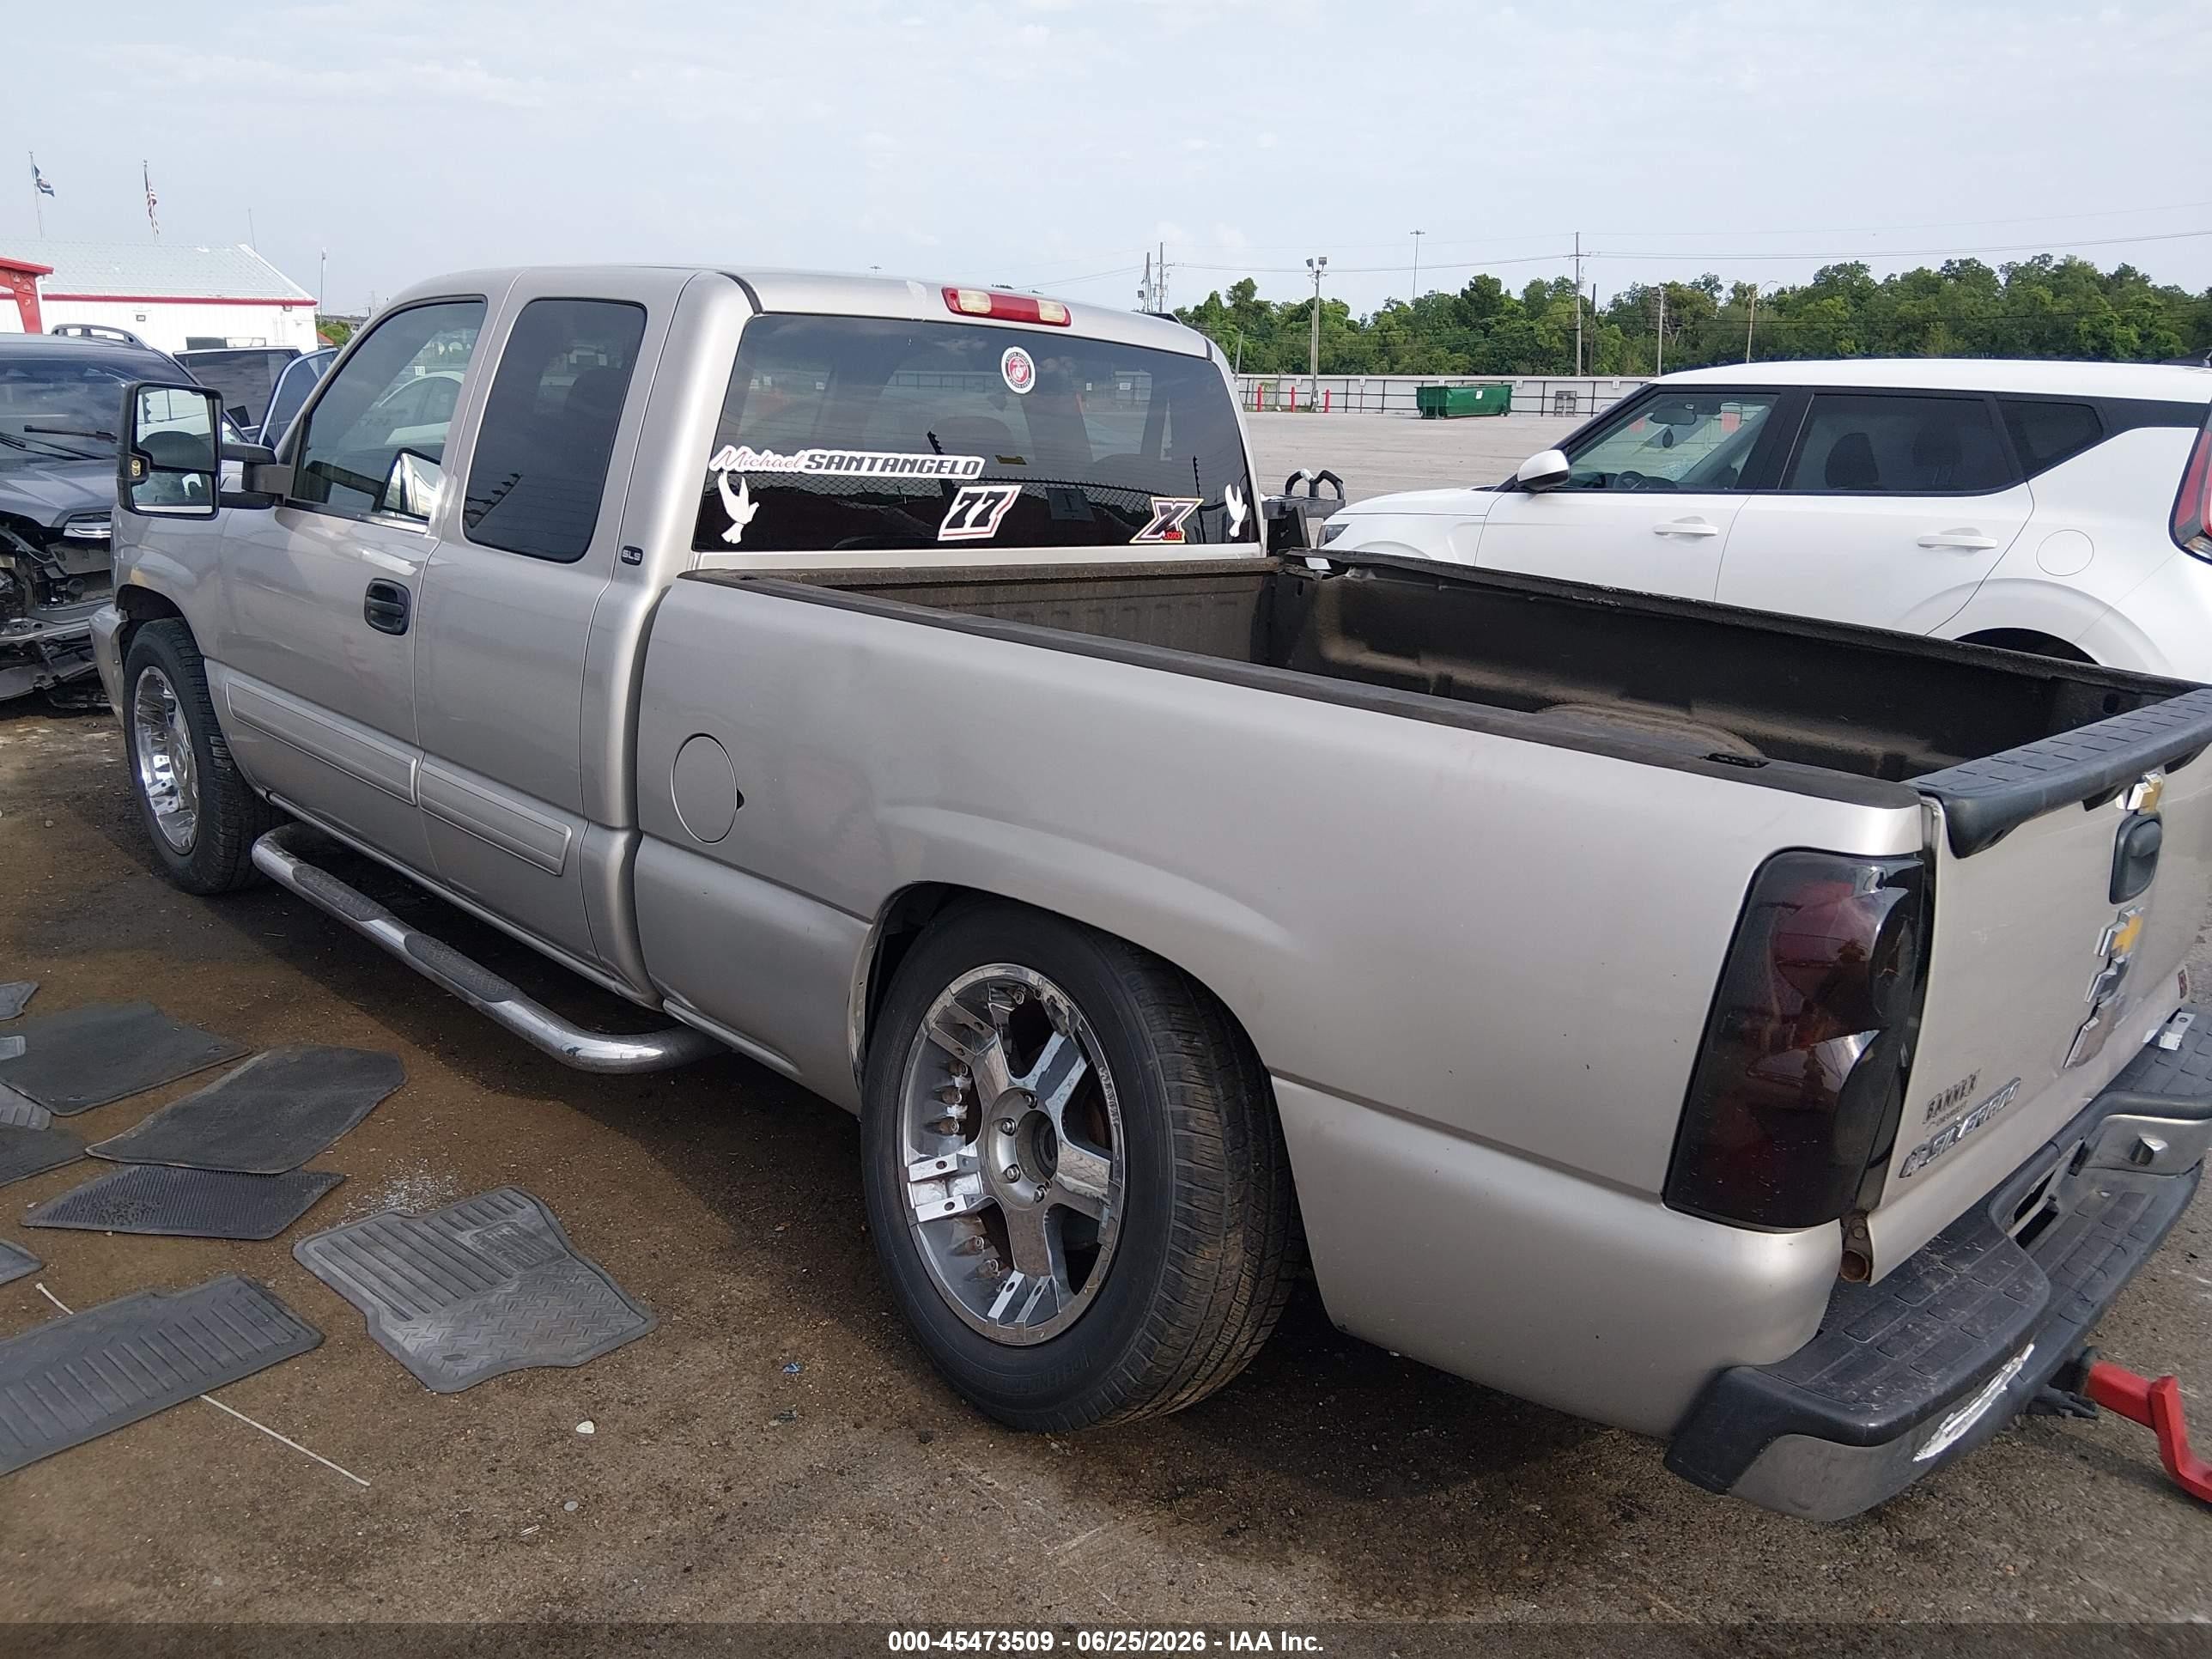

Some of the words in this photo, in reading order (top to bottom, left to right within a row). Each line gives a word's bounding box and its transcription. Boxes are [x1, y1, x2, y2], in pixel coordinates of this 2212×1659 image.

[714, 450, 805, 469] Michael
[805, 453, 981, 476] SANTANGELO
[944, 490, 1010, 530] 77
[622, 549, 641, 562] SLS
